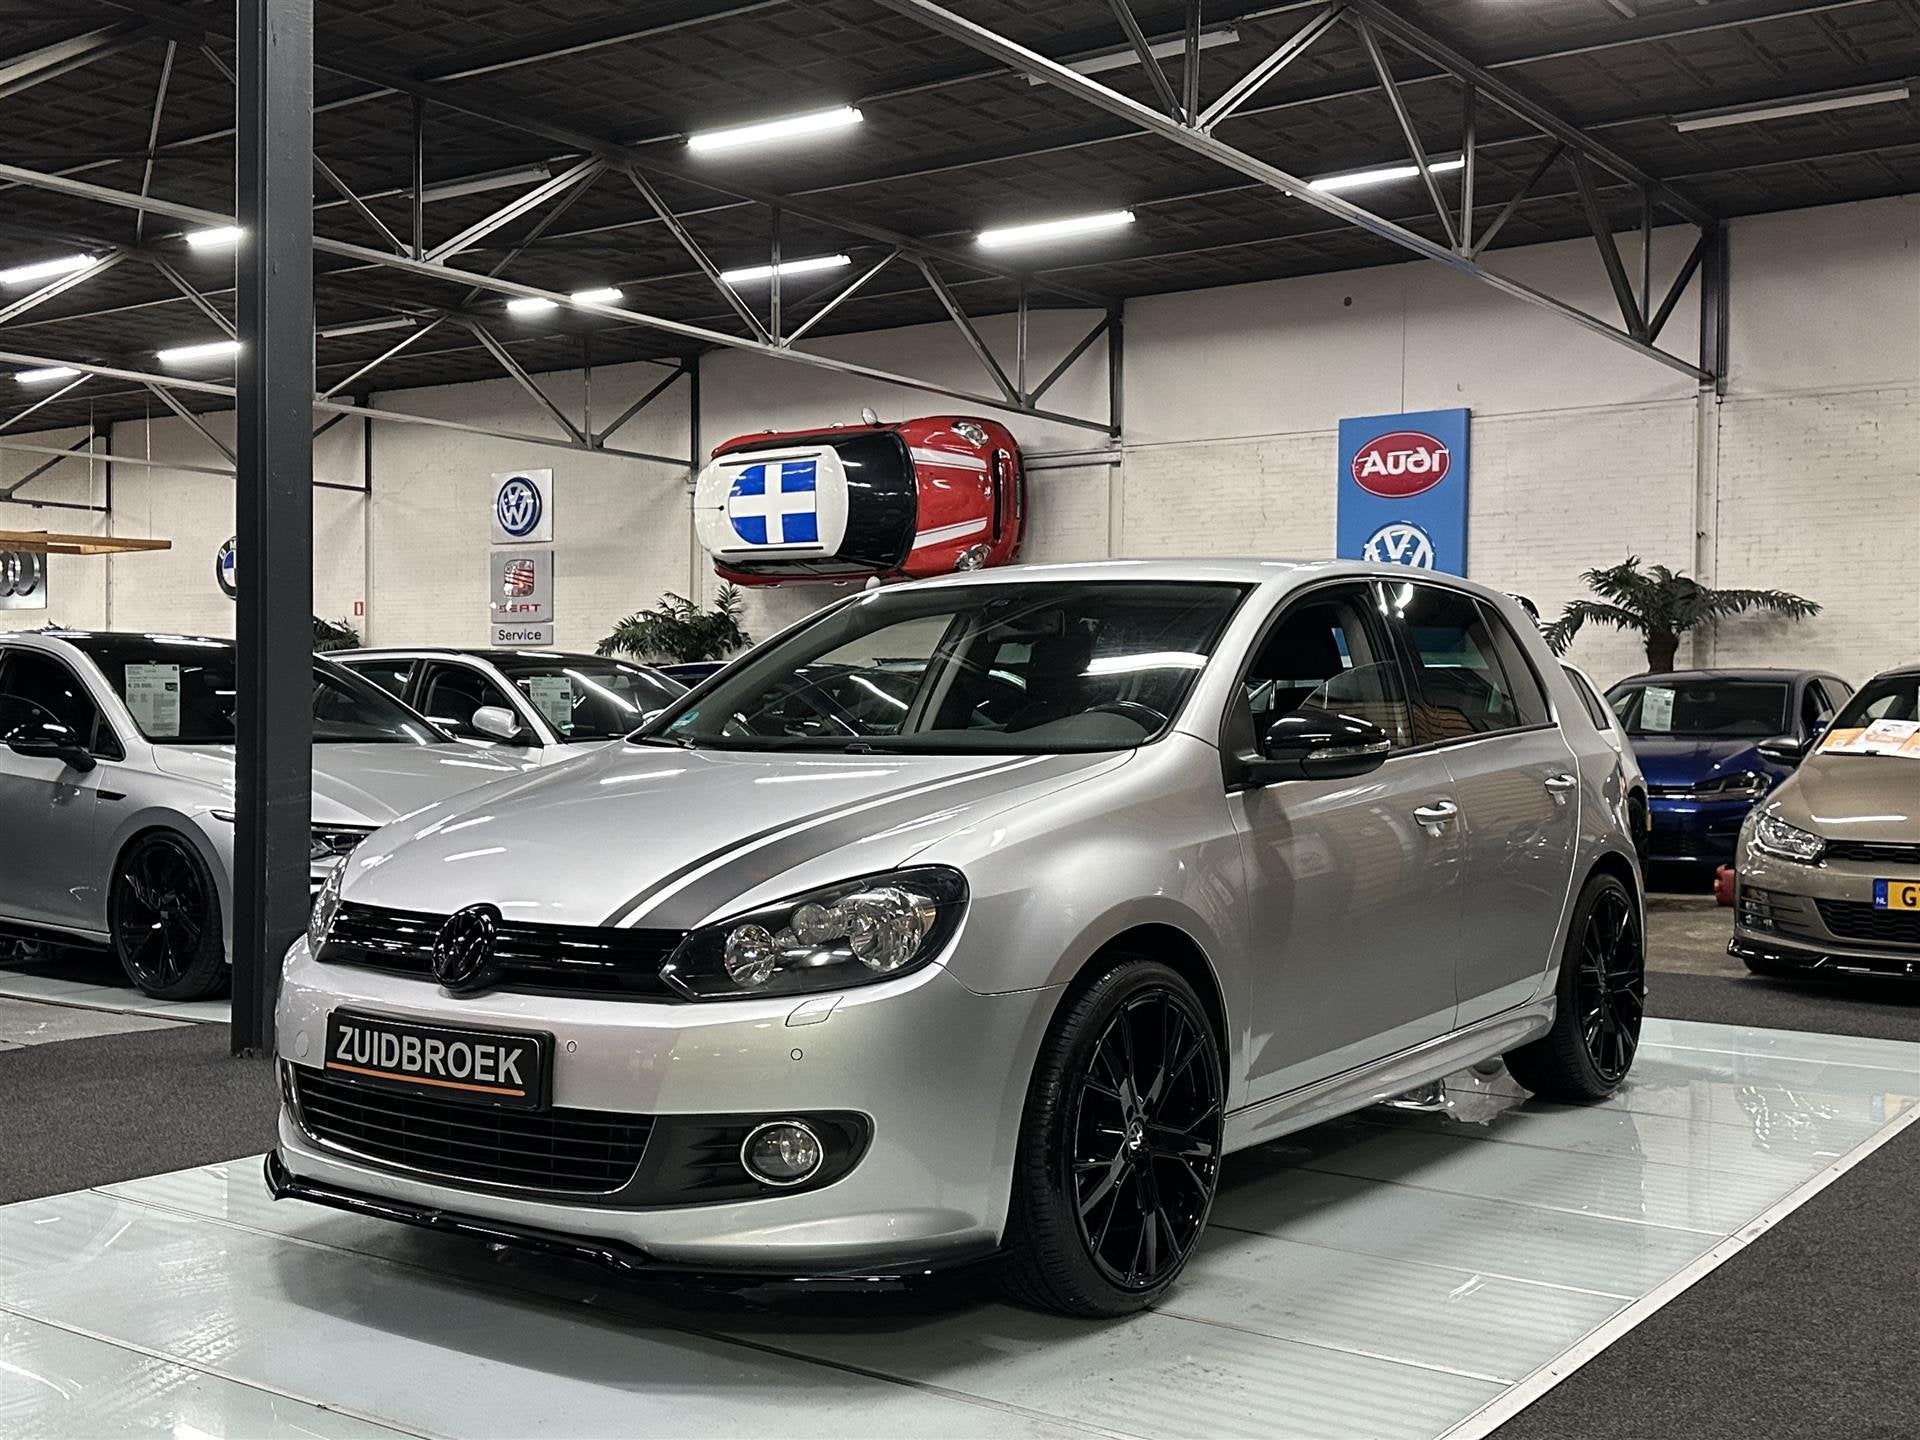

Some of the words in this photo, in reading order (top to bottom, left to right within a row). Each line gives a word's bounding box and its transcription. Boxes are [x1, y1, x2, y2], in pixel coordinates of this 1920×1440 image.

[498, 602, 541, 614] SEAT
[498, 628, 542, 641] Service
[1875, 896, 1887, 905] NL
[1902, 886, 1920, 907] G
[336, 1025, 523, 1085] ZUIDBROEK
